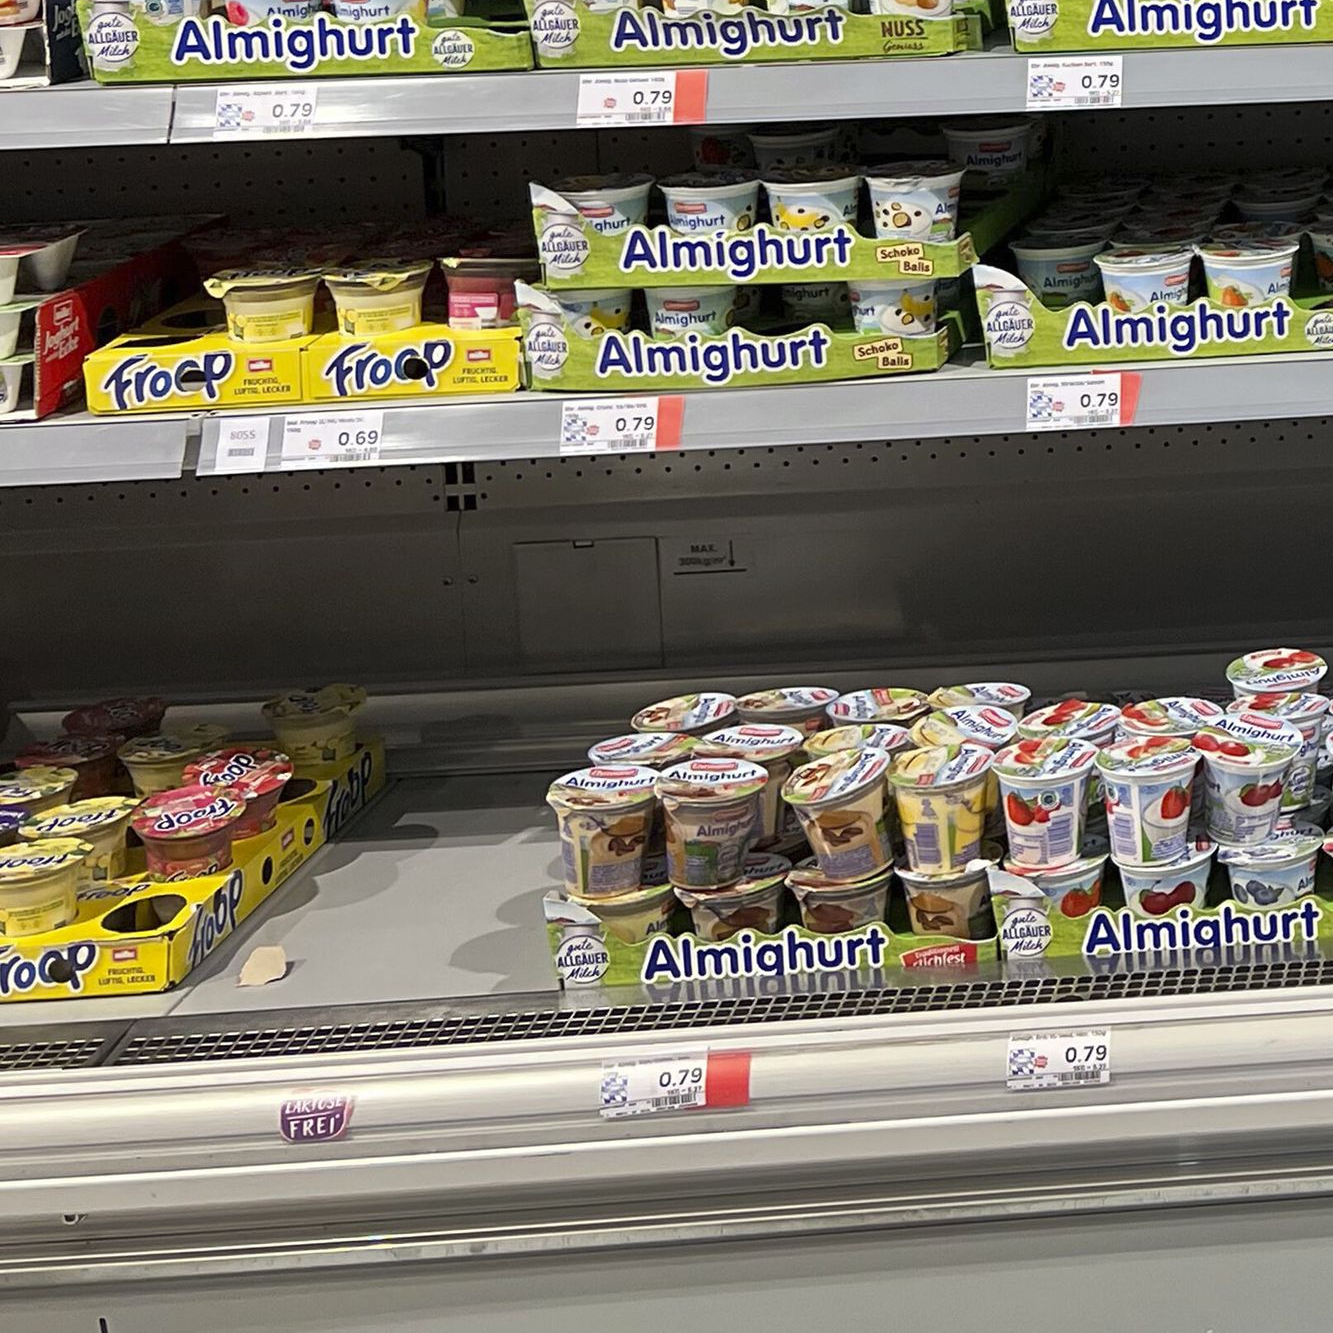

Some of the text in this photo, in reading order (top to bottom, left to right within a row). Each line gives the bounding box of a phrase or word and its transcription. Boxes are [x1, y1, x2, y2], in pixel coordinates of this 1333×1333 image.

[1010, 2, 1058, 19] ALLGÄUER
[97, 15, 125, 31] gute
[613, 5, 845, 56] Almighurt
[881, 18, 925, 37] NUSS
[1018, 15, 1051, 31] Milch
[88, 27, 139, 47] ALLGÄUER
[174, 17, 417, 70] Almighurt
[97, 43, 131, 59] Milch
[1081, 73, 1120, 89] 0.79
[633, 90, 673, 105] 0.79
[271, 102, 312, 119] 0.79
[621, 223, 855, 278] Almighurt
[880, 244, 922, 260] Schoko
[903, 259, 932, 275] Balls
[1064, 301, 1291, 350] Almighurt
[597, 328, 830, 382] Almighurt
[1079, 392, 1118, 409] 0.79
[615, 415, 655, 432] 0.79
[338, 430, 379, 447] 0.69
[1212, 714, 1296, 743] Almighurt
[1084, 901, 1320, 955] Almighurt
[642, 927, 887, 983] Almighurt
[1064, 1044, 1108, 1062] 0.79
[658, 1068, 703, 1088] 0.79
[285, 1097, 345, 1114] LAKTOSE
[288, 1117, 338, 1137] FREI
